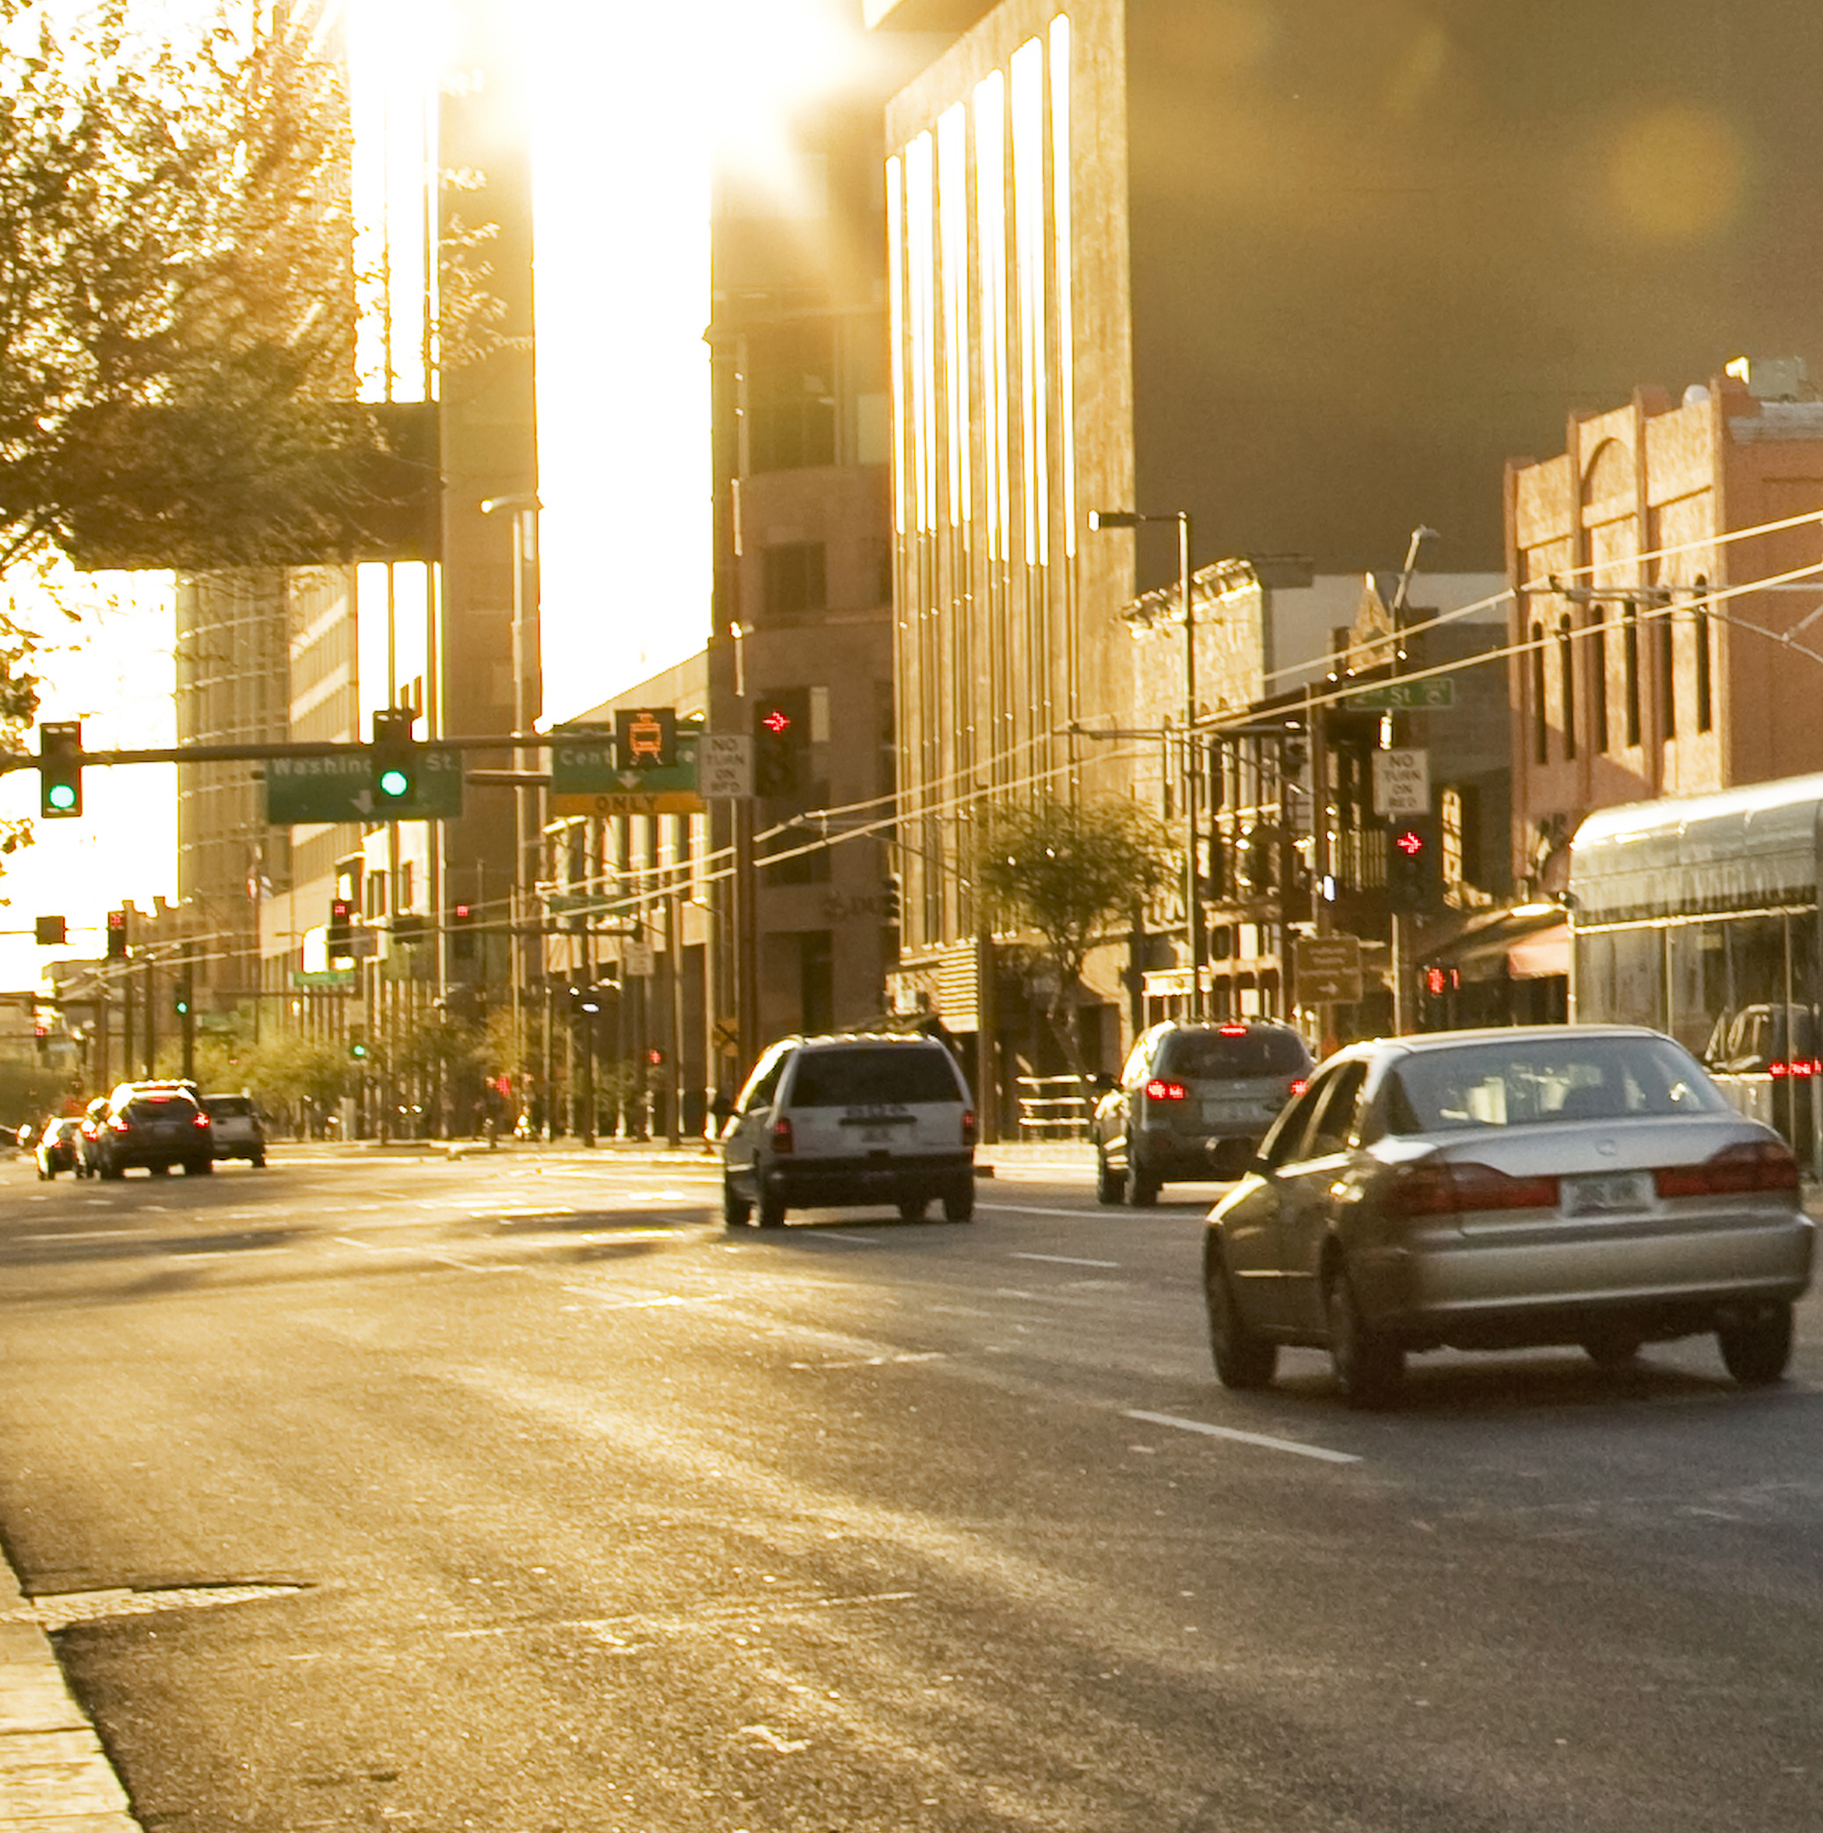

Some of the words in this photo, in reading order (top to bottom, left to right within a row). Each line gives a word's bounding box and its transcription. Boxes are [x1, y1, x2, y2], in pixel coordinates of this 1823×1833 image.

[712, 738, 739, 752] NO
[1389, 753, 1414, 768] NO
[1382, 769, 1423, 782] TURN
[596, 795, 653, 811] ONLY
